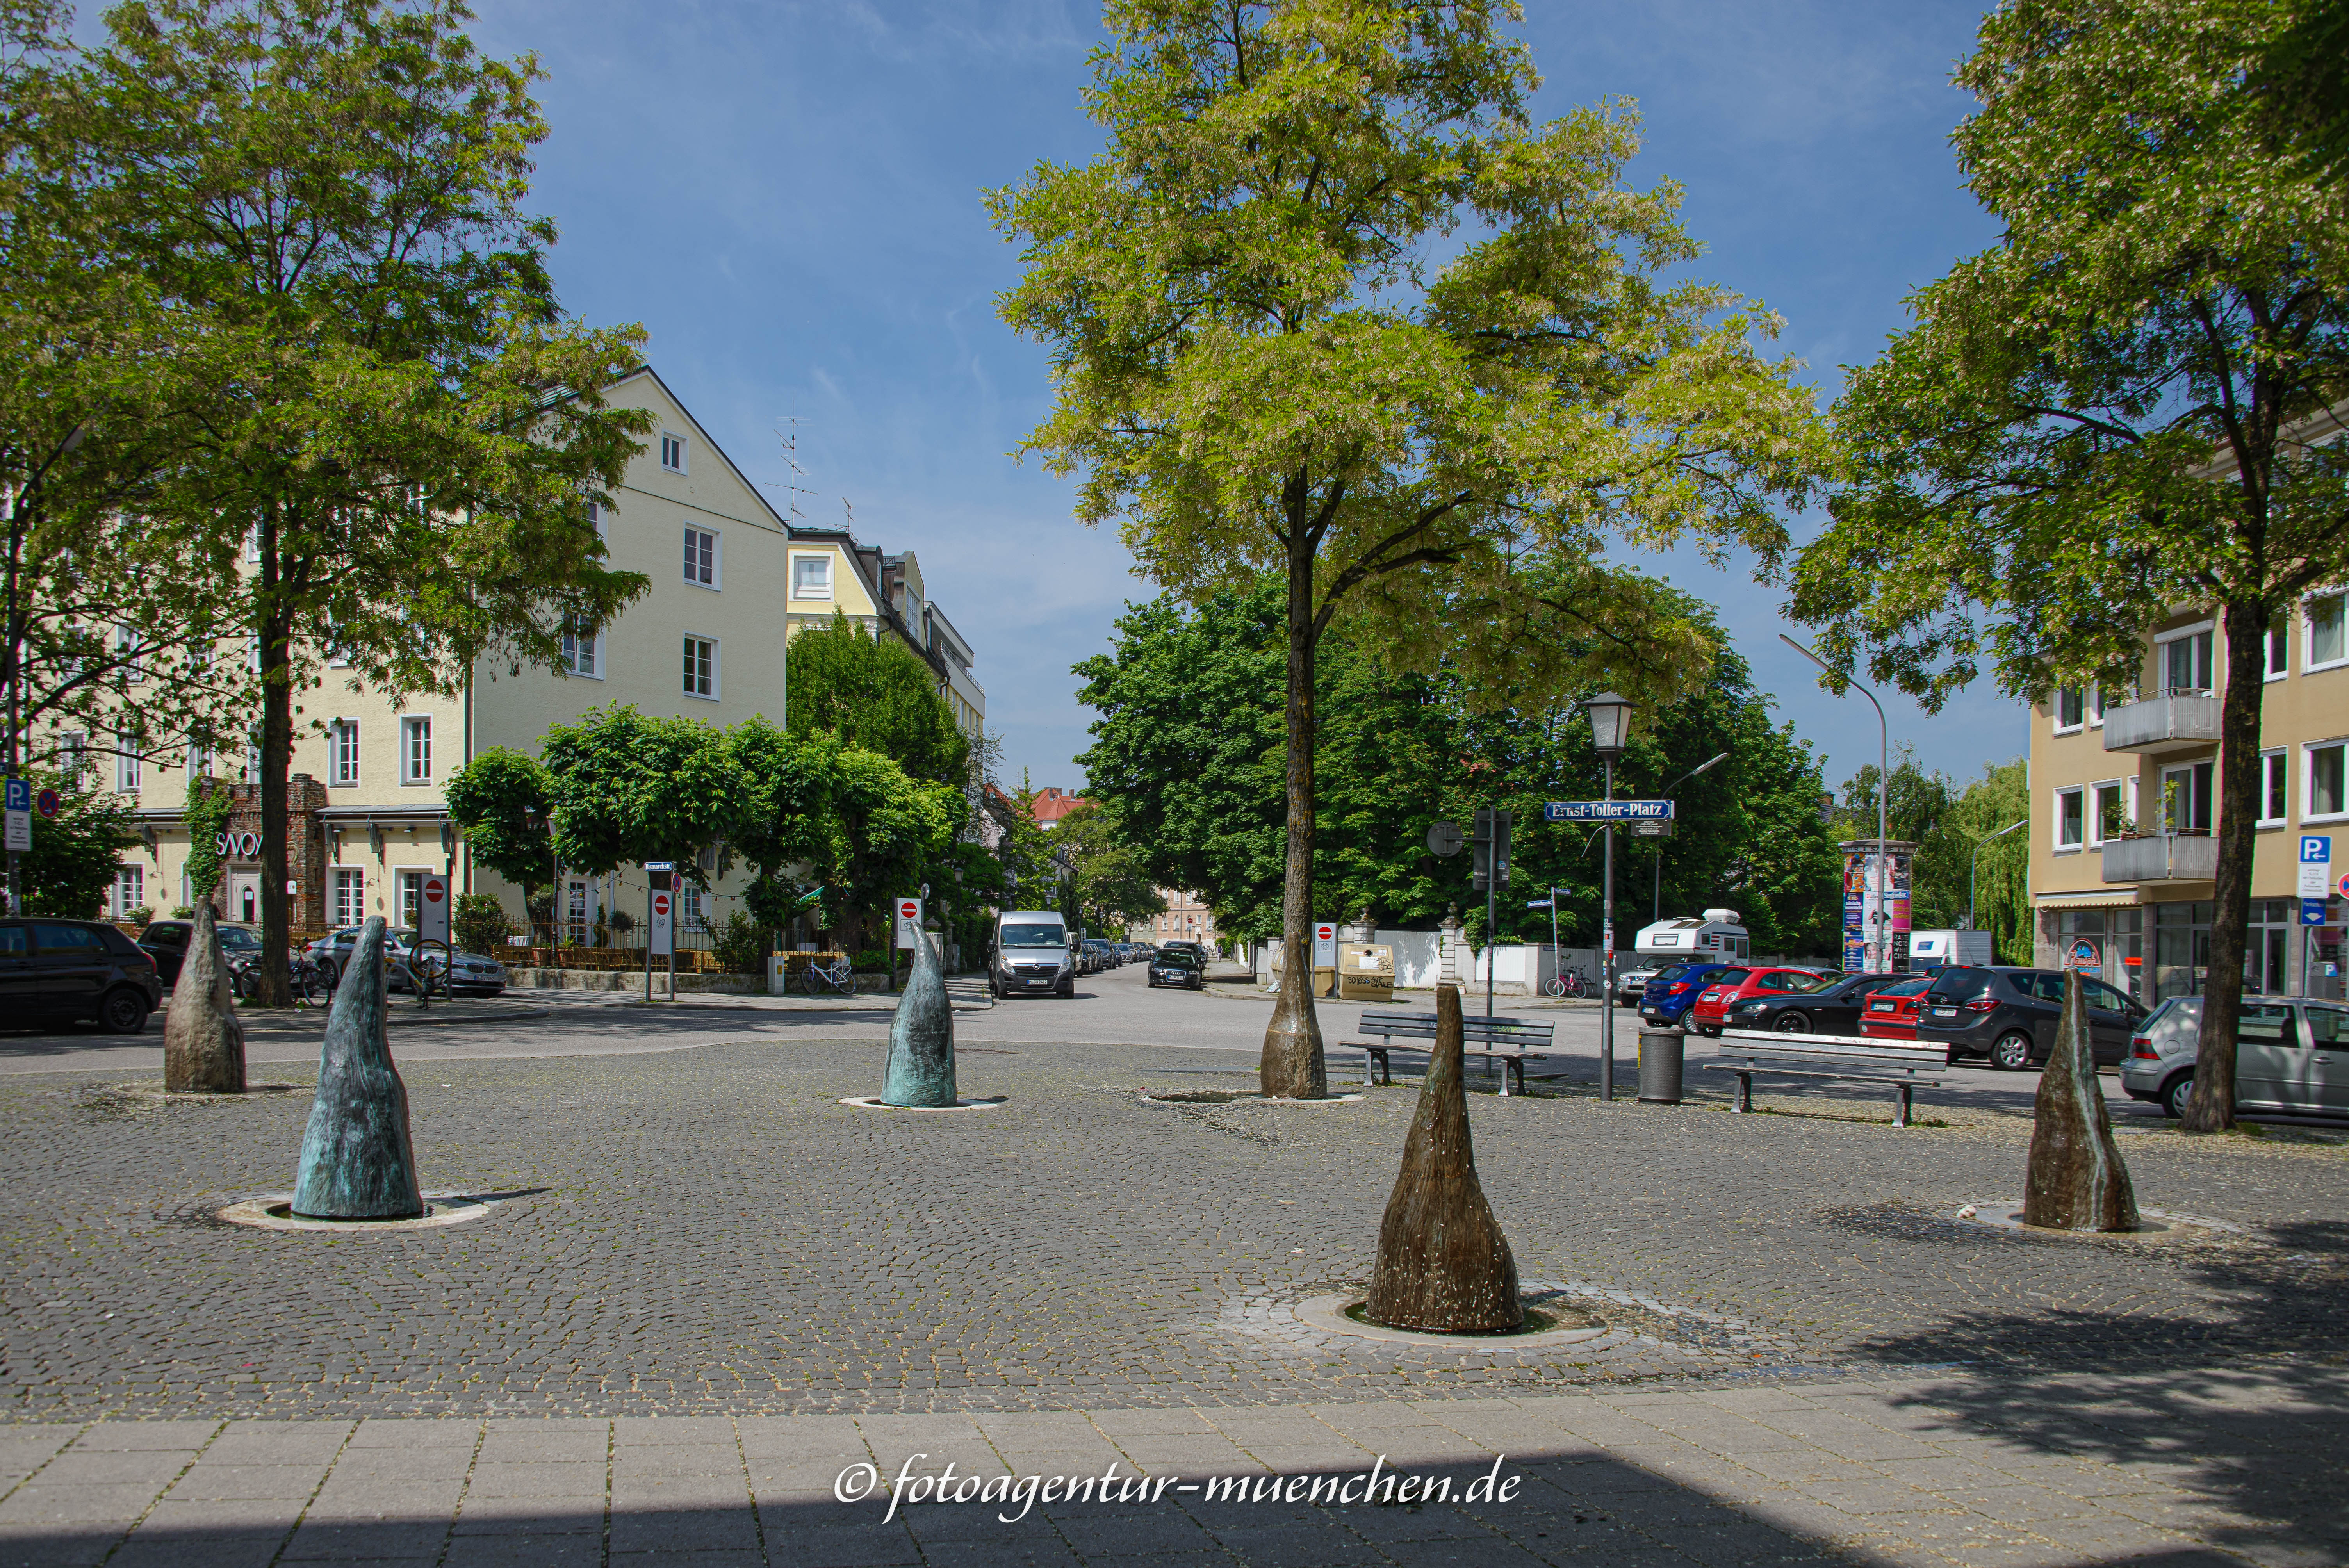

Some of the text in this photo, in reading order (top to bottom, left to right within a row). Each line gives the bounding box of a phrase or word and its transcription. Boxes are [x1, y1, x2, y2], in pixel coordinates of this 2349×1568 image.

[9, 783, 23, 806] P
[1552, 803, 1662, 816] Ernst-Toller-Platz
[216, 832, 263, 855] SAVOY
[2304, 839, 2322, 859] P
